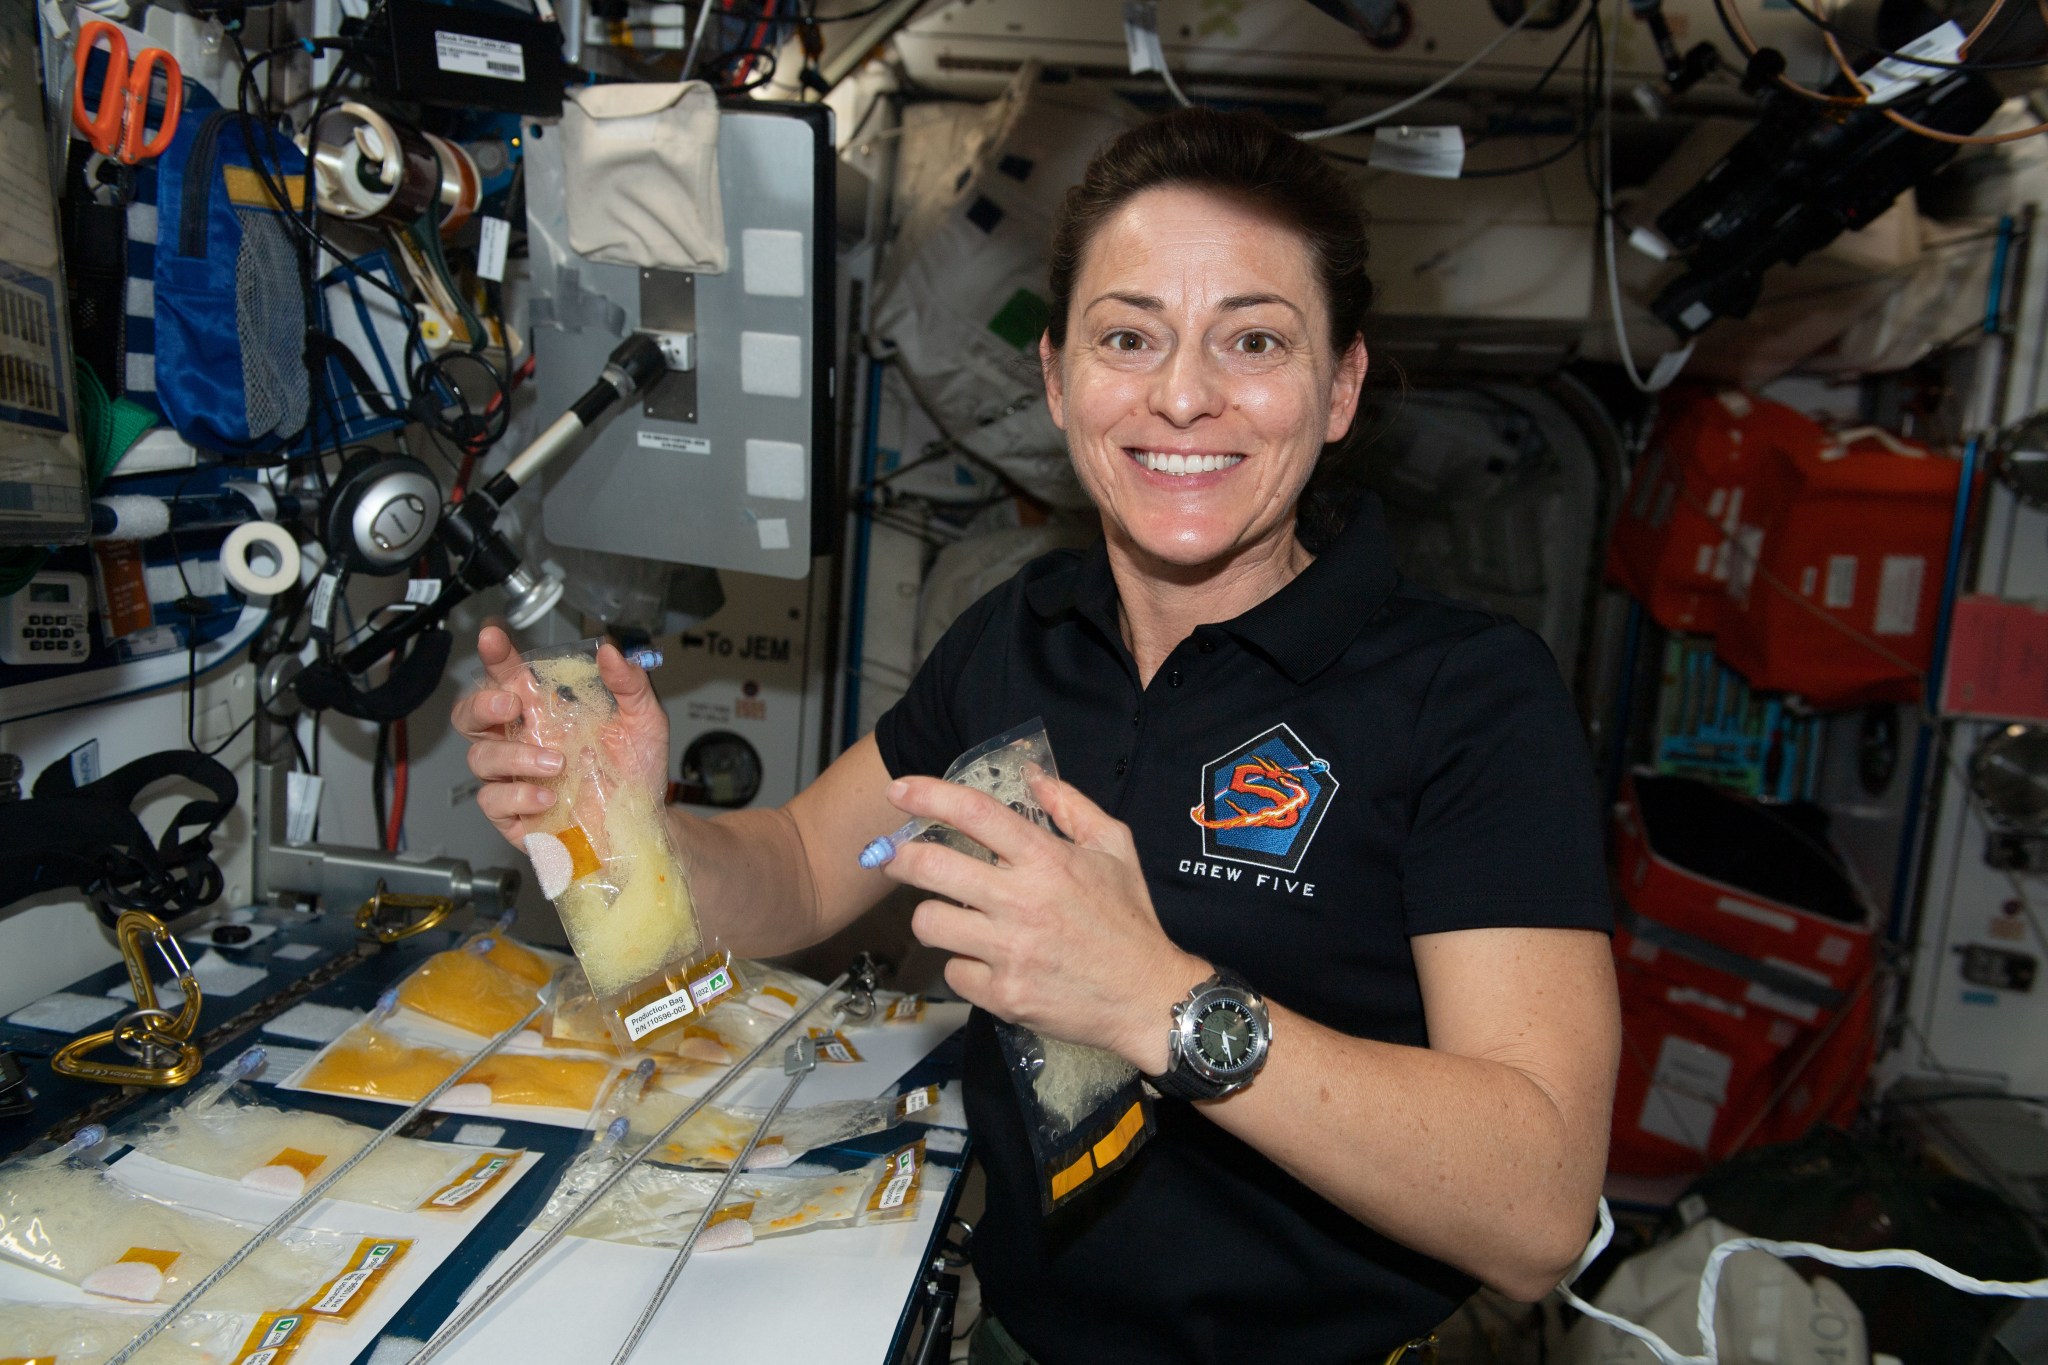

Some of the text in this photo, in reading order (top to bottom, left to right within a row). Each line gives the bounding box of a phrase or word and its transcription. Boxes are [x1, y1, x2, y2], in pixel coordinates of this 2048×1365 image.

[706, 630, 790, 663] To JEM
[1178, 859, 1316, 897] CREW FIVE
[631, 995, 684, 1026] Production Bag
[635, 1004, 686, 1034] P/N 110596-002
